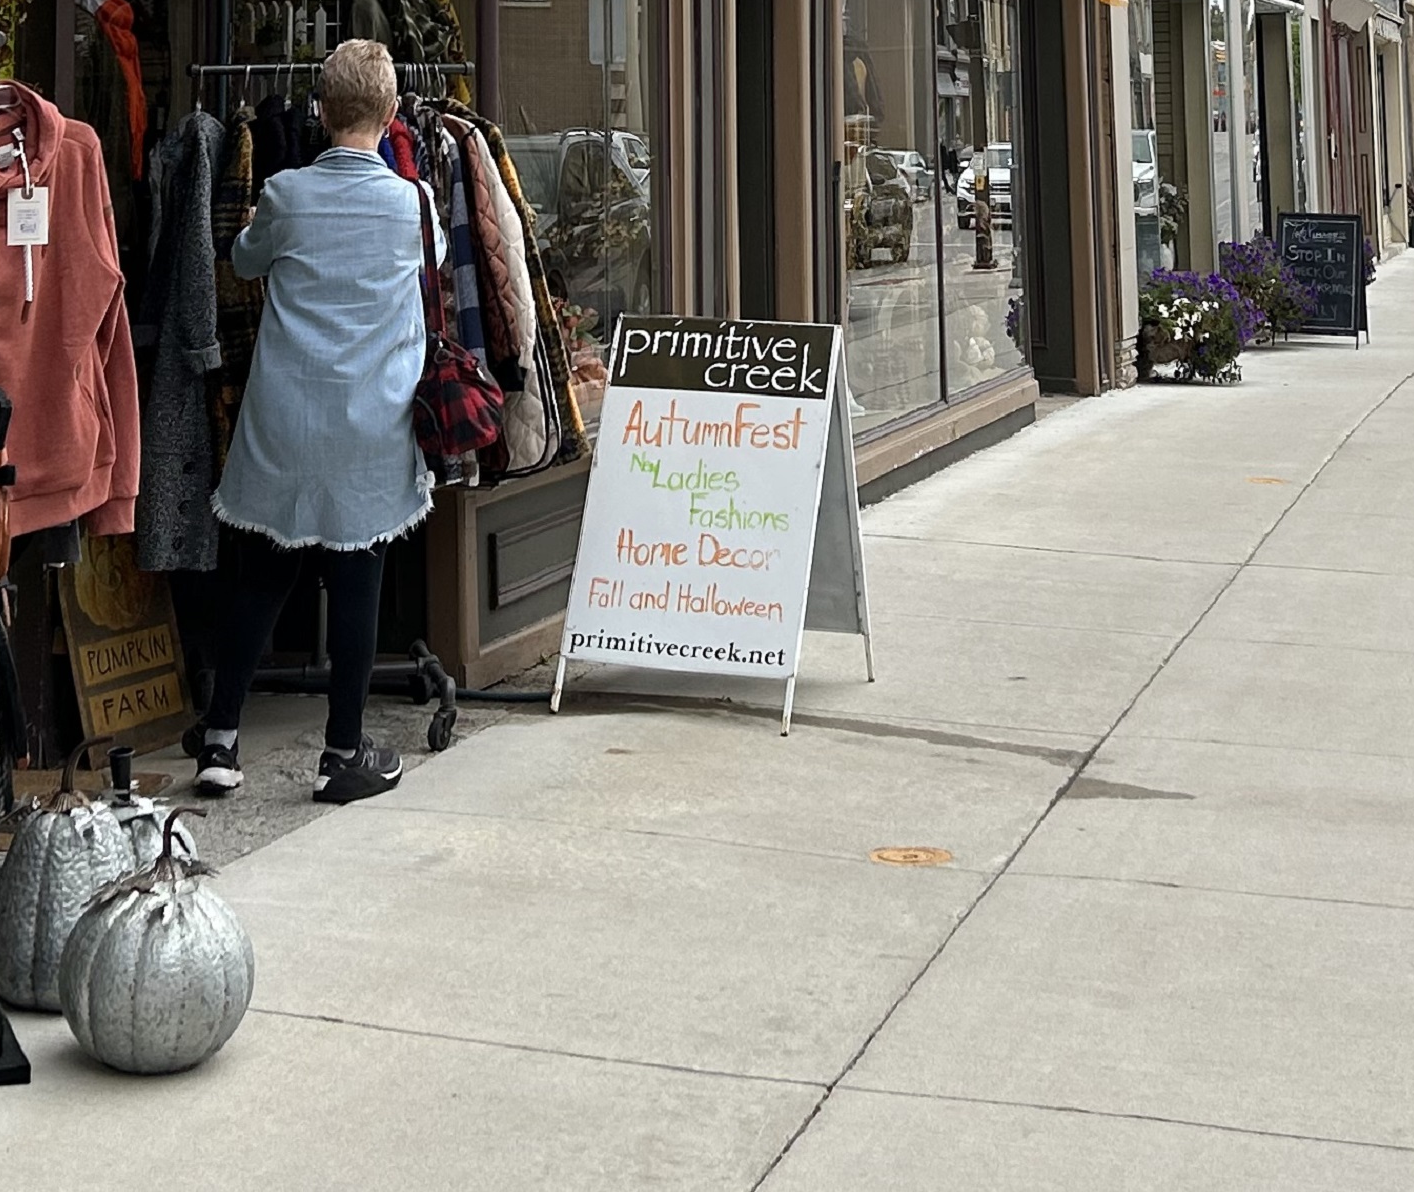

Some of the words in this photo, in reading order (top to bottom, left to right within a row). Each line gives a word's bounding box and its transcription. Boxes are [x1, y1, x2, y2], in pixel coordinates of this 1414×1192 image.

[1286, 245, 1322, 262] STOP
[1323, 248, 1346, 263] IN
[620, 320, 797, 377] primitive
[704, 342, 824, 394] creek
[651, 459, 740, 492] Ladies
[689, 492, 789, 532] Fashions
[616, 527, 687, 568] Home
[698, 533, 781, 571] Decor
[588, 577, 623, 609] Fall
[631, 581, 668, 611] and
[677, 583, 783, 622] Halloween
[87, 633, 167, 676] PUMPKIN
[569, 629, 786, 667] primitivecreek.net
[102, 684, 170, 725] FARM
